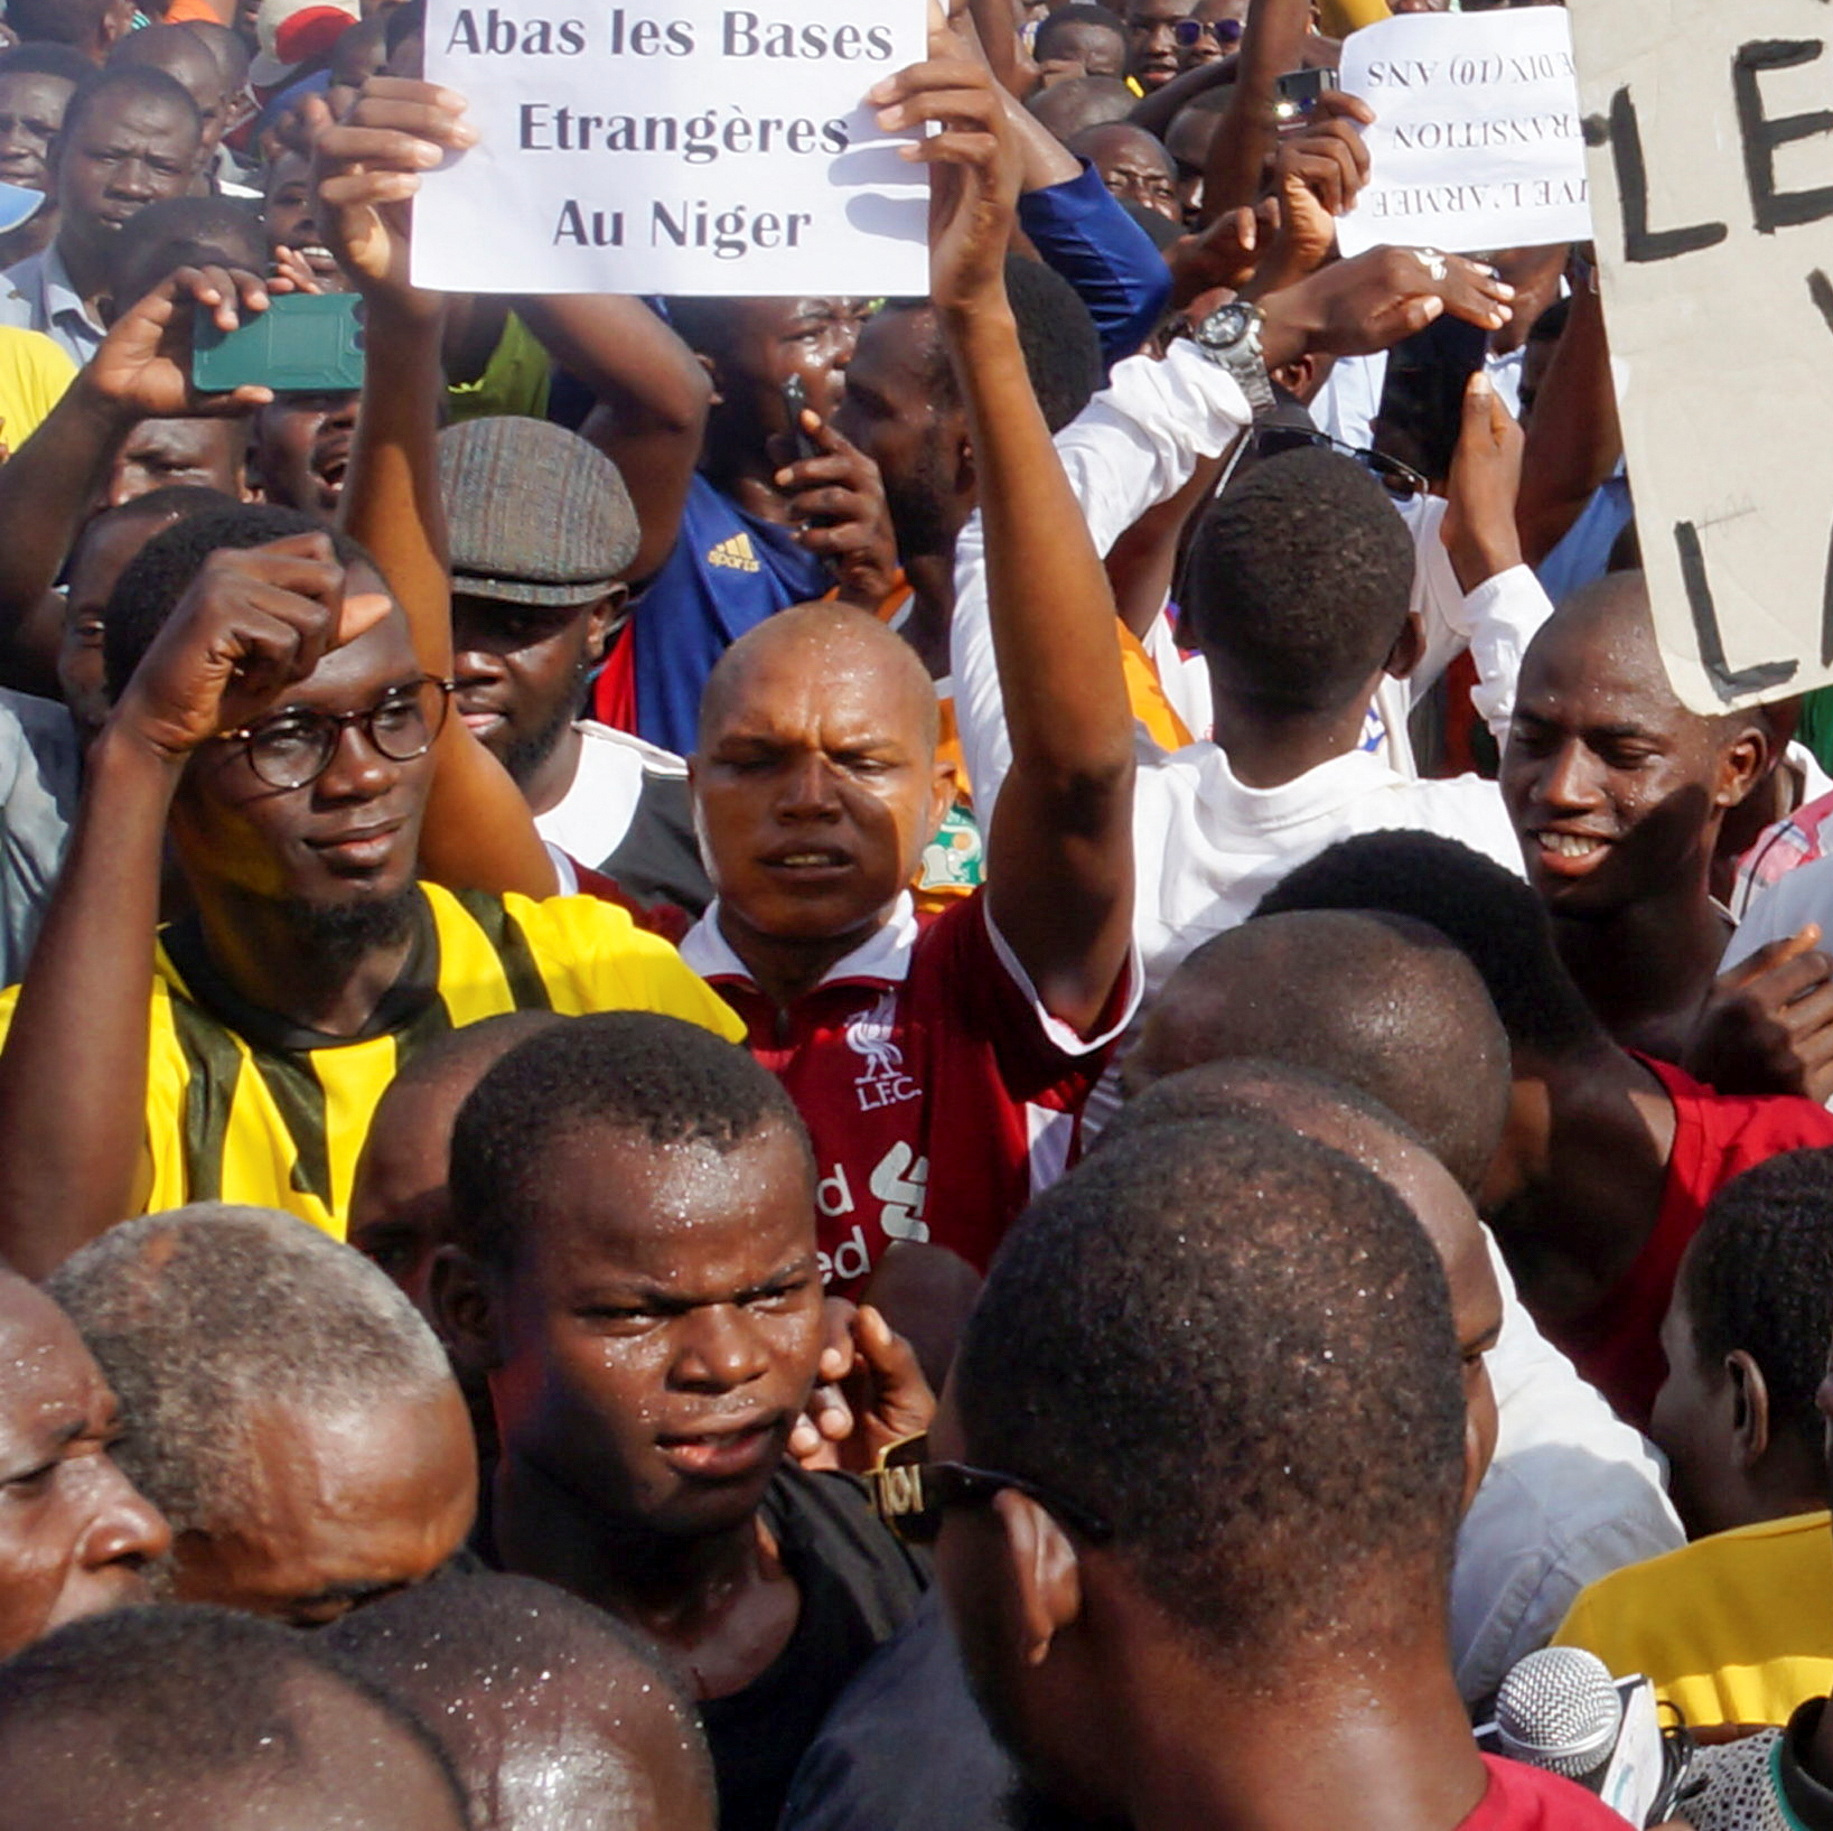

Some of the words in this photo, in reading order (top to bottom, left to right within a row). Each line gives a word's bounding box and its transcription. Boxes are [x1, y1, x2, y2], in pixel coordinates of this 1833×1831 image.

[445, 8, 587, 55] Abas
[611, 8, 695, 56] les
[722, 10, 894, 61] Bases
[1366, 60, 1438, 88] ANS
[1450, 53, 1503, 86] (10)
[519, 103, 850, 164] Etrangères
[552, 199, 625, 248] Au
[650, 200, 812, 260] Niger
